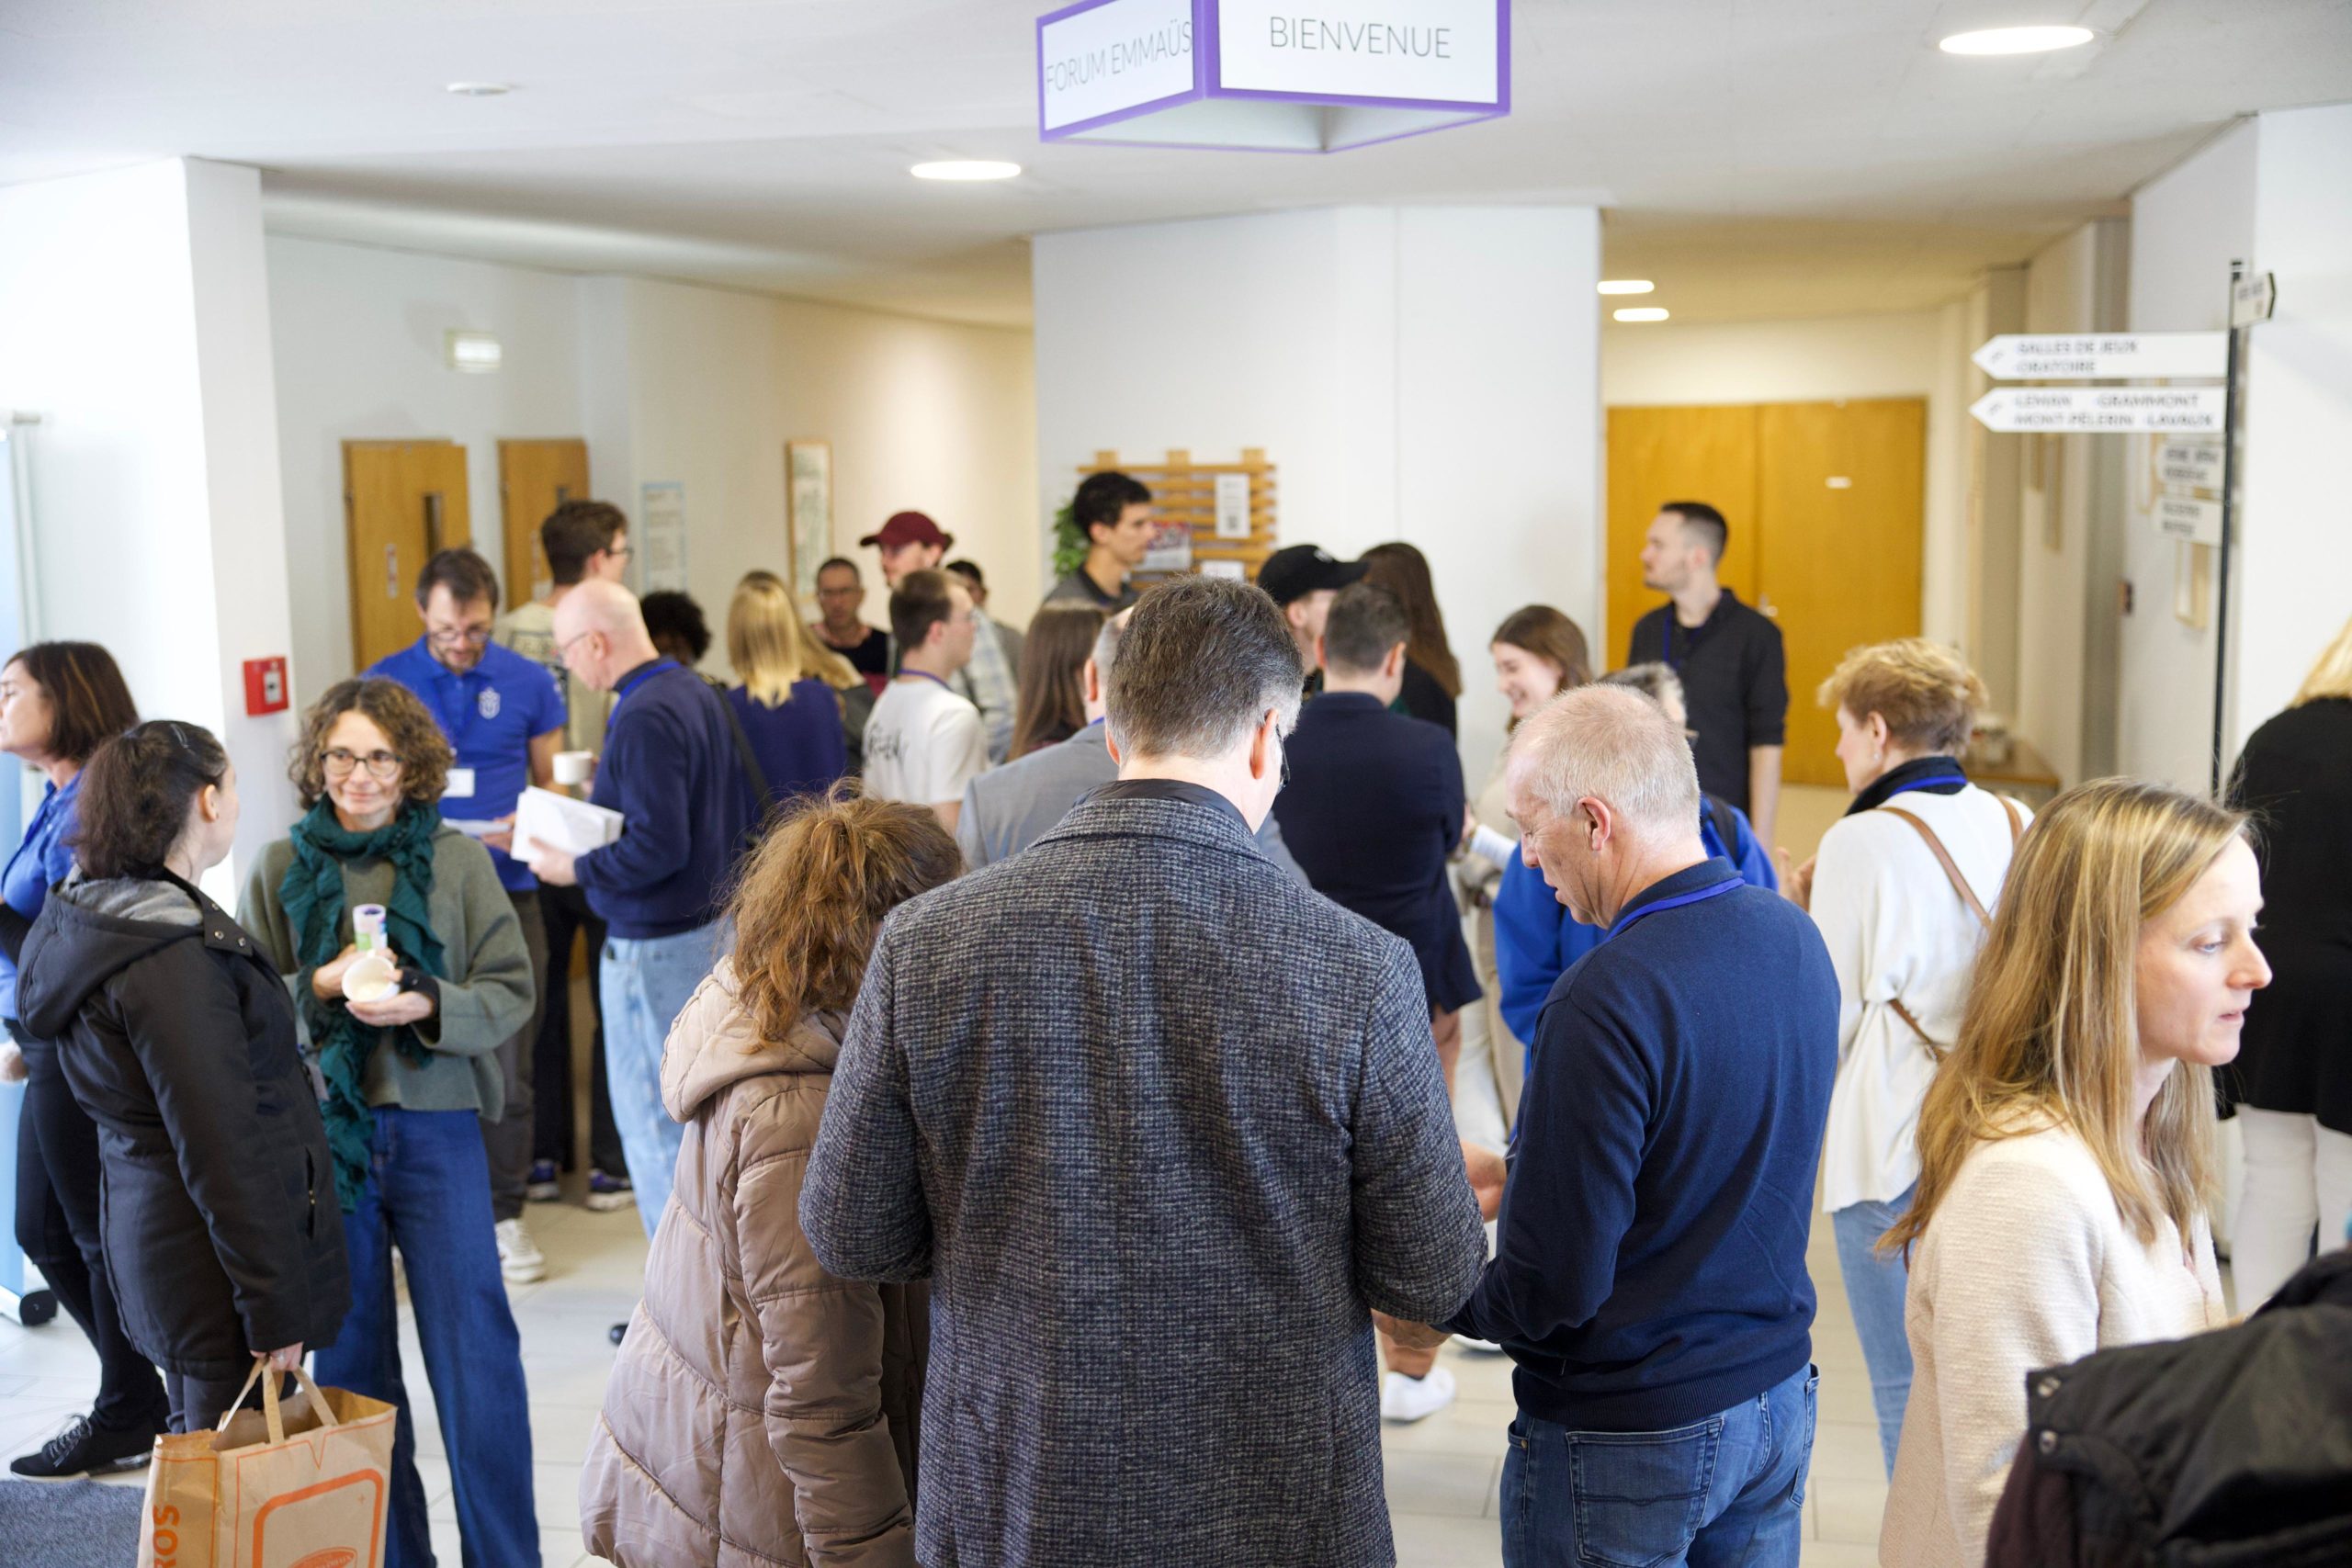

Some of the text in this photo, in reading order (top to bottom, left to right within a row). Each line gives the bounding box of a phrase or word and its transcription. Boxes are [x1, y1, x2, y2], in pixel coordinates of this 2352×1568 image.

[1270, 17, 1452, 59] BIENVENUE
[1046, 18, 1193, 94] FORUM EMMAÜS
[2017, 338, 2139, 355] SALLES DE JEUX
[2016, 359, 2097, 374] ORATOIRE
[2096, 392, 2199, 408] GRAMMONT
[2014, 412, 2064, 427] MONT
[2146, 412, 2214, 427] LAVAUX
